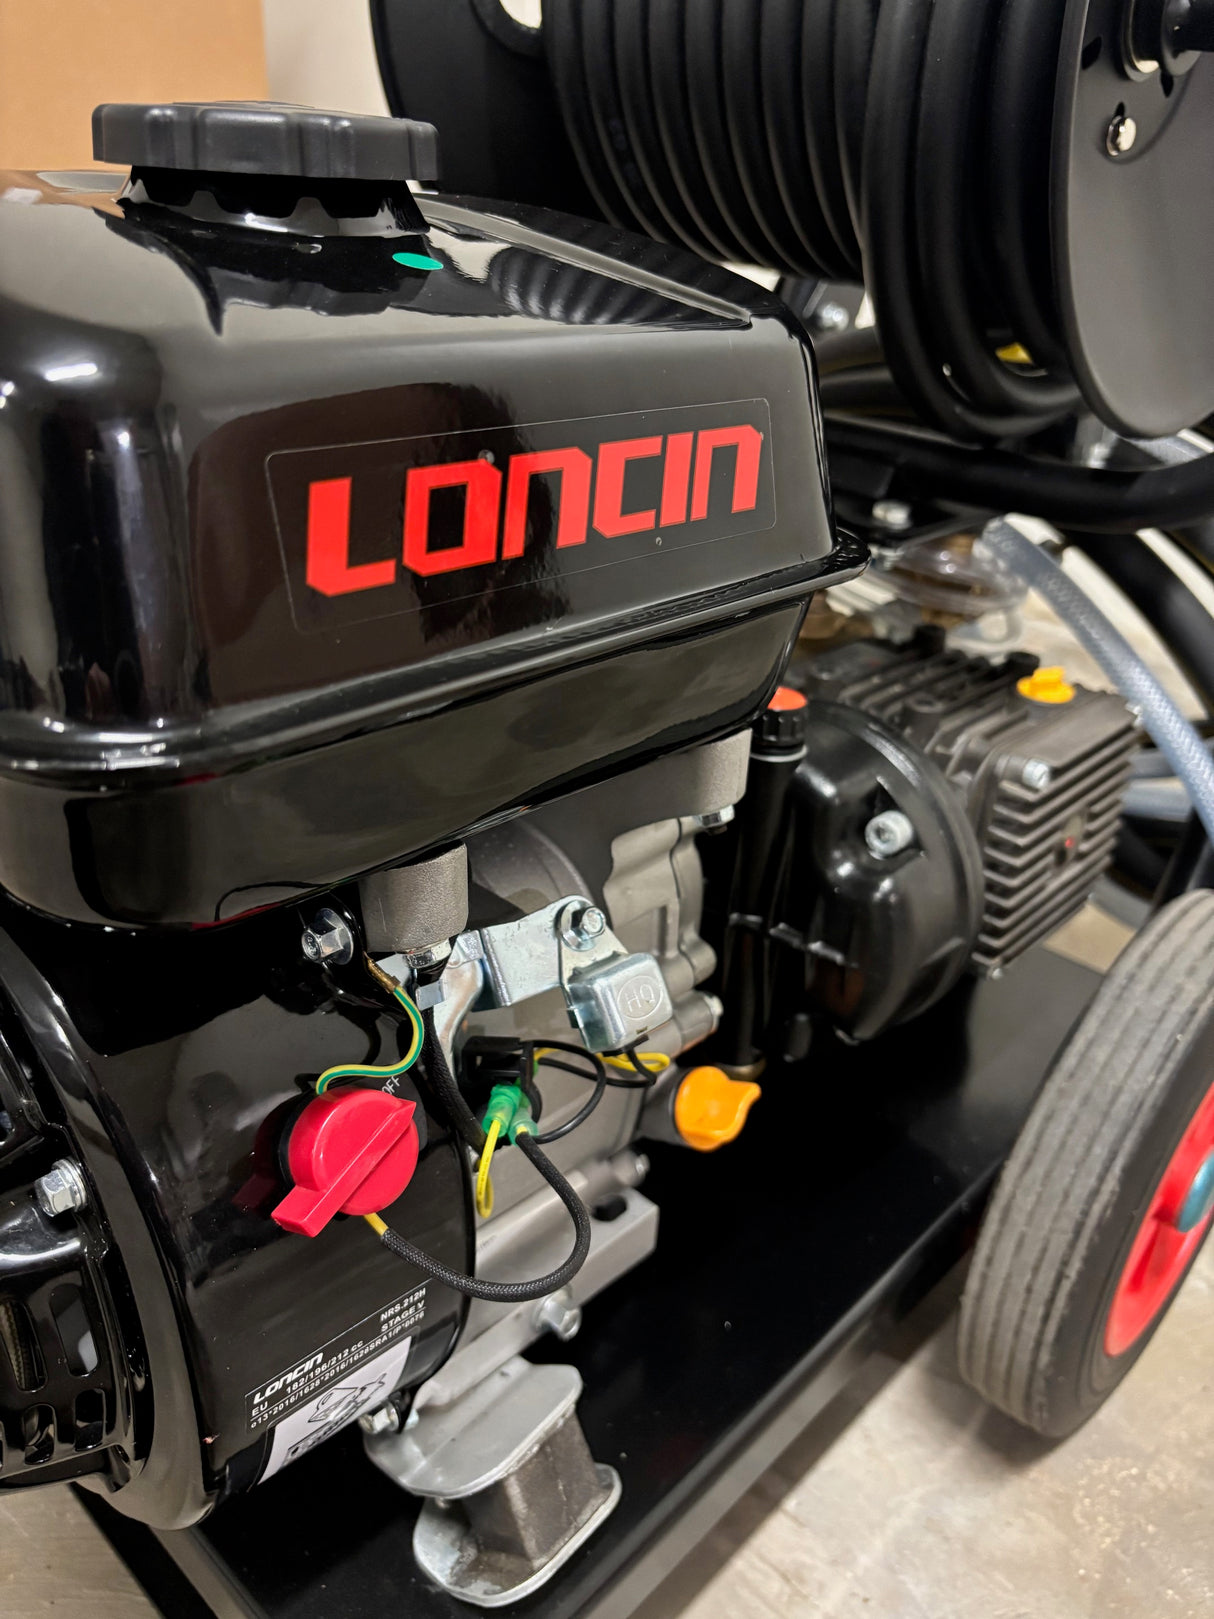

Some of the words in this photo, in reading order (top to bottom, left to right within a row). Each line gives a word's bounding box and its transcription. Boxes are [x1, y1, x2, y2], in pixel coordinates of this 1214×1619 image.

[306, 424, 763, 597] LONCIN
[626, 984, 655, 1012] HQ
[381, 1287, 426, 1322] NRS.212H
[381, 1305, 416, 1332] STAGE
[417, 1299, 425, 1309] V
[252, 1401, 268, 1417] EU
[286, 1348, 350, 1394] 182/196/212
